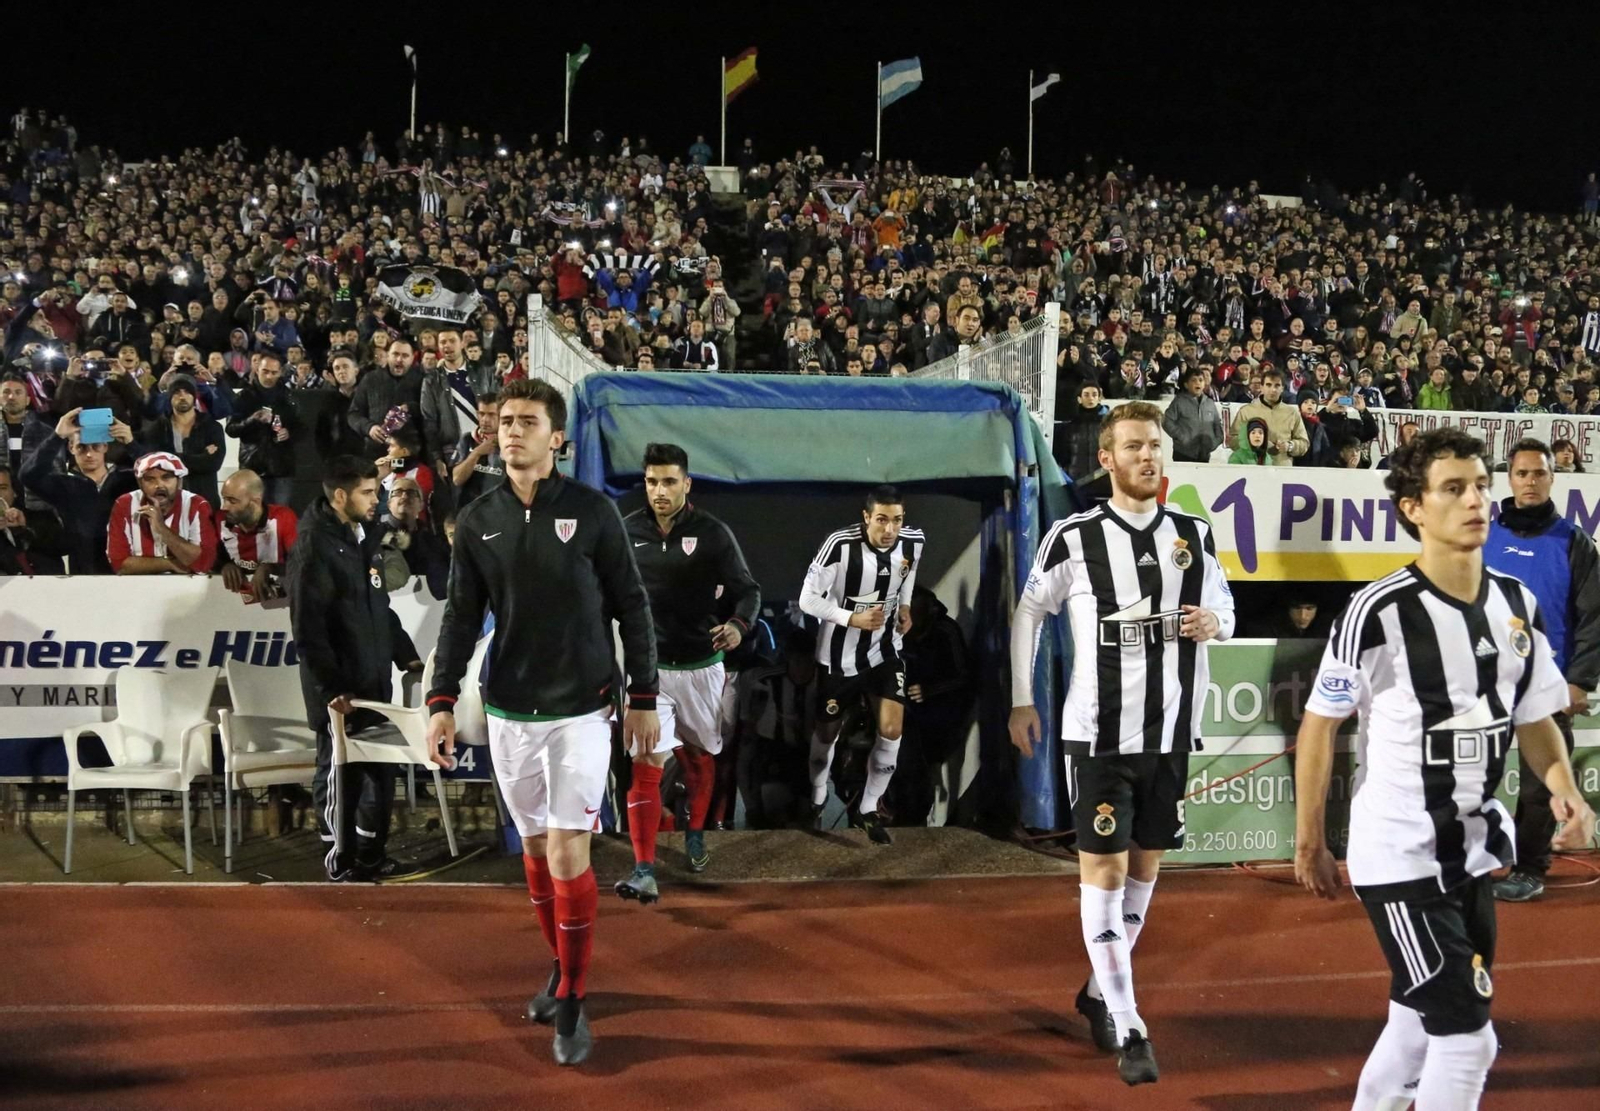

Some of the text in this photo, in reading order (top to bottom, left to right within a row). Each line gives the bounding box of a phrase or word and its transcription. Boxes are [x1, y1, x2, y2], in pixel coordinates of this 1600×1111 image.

[1279, 483, 1397, 542] PINT
[175, 648, 201, 669] e
[10, 686, 112, 706] Y MARI
[1189, 769, 1295, 811] design
